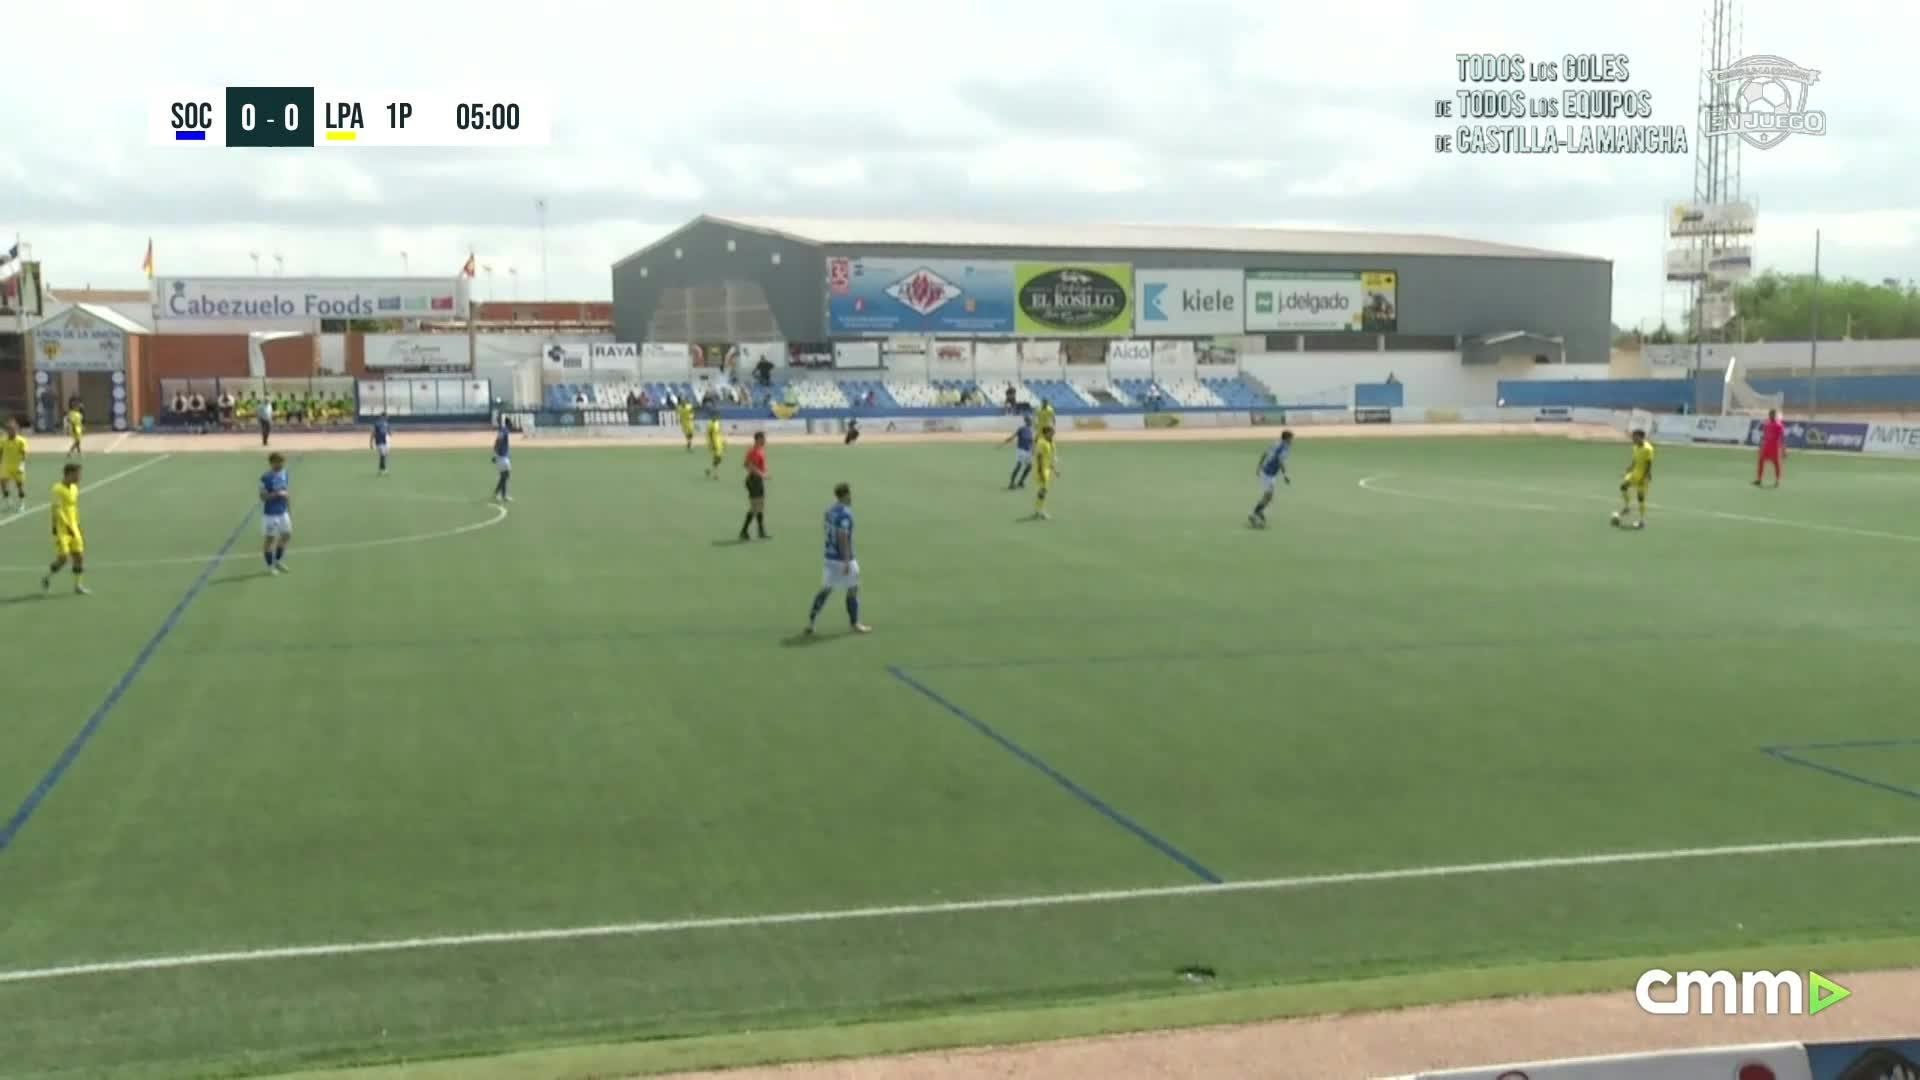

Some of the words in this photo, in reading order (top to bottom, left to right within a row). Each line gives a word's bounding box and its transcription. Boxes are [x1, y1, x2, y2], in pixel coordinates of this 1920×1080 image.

[169, 289, 296, 316] Cabezuelo
[304, 294, 374, 315] Foods
[1032, 293, 1052, 309] EL
[1182, 290, 1235, 312] kiele
[1278, 290, 1350, 314] j.delgado
[595, 346, 635, 358] RAYA
